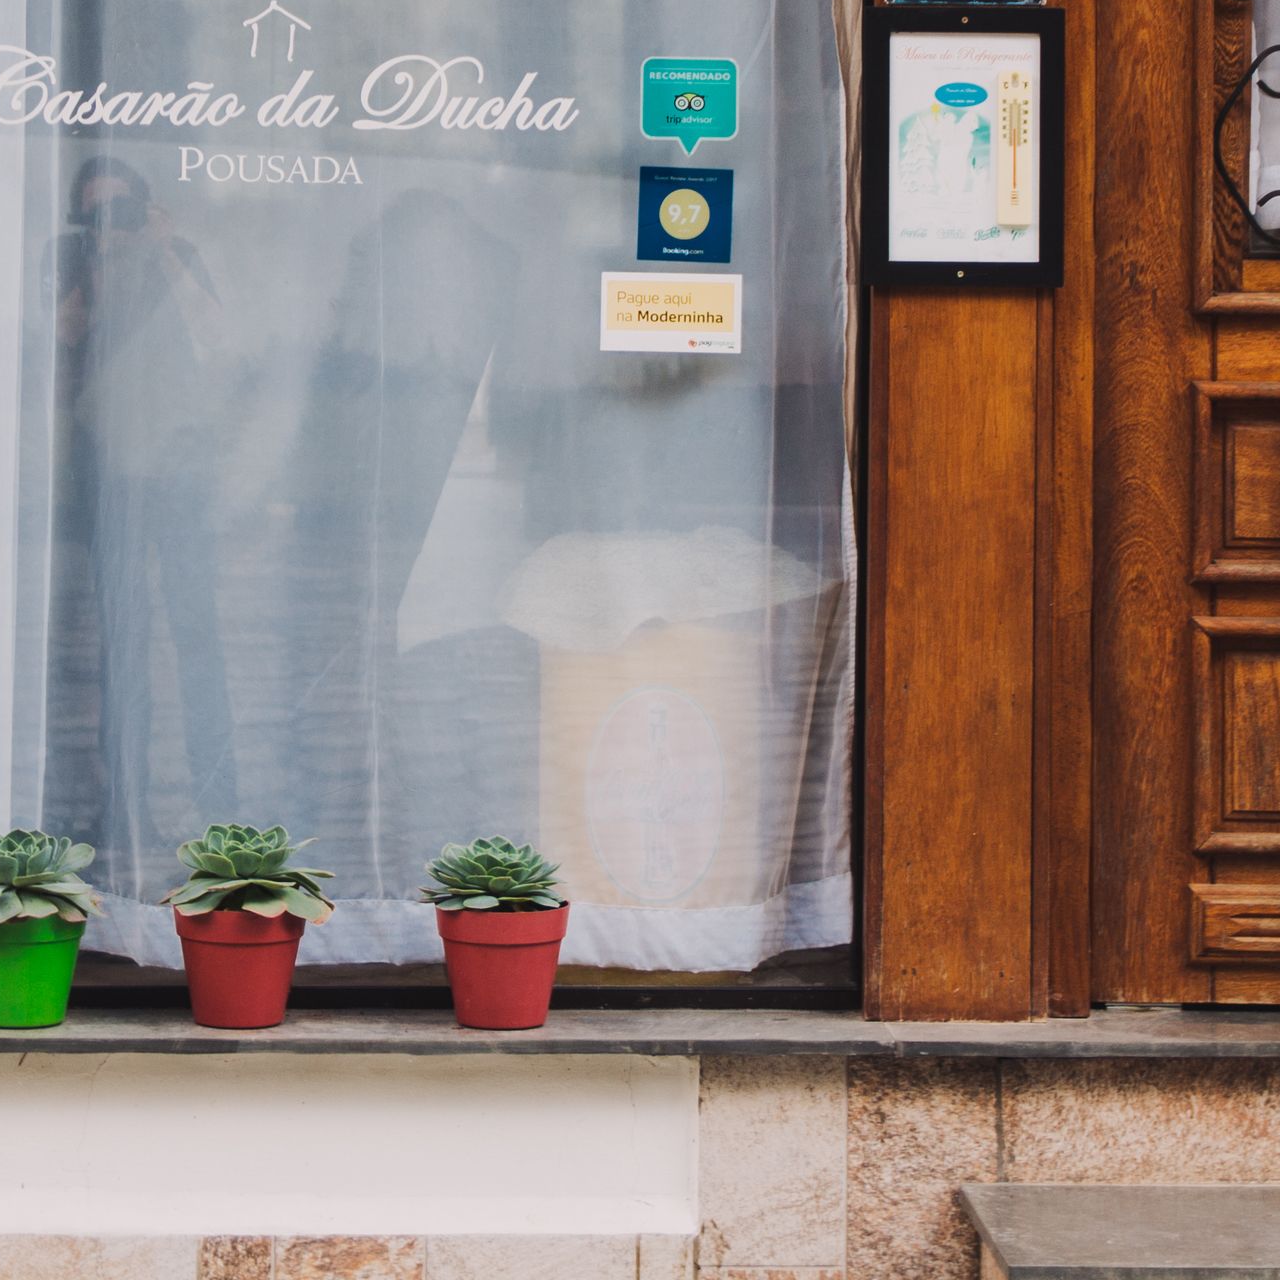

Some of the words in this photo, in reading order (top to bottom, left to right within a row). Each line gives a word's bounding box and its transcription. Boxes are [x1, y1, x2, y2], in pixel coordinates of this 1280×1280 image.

[957, 47, 1033, 65] Refrigerante
[649, 71, 731, 81] RECOMENDADO
[257, 69, 342, 129] da
[353, 53, 579, 133] Ducha
[666, 114, 713, 125] tripadvisor
[667, 203, 701, 225] 9,7
[662, 246, 704, 256] Booking.com
[616, 290, 660, 307] Pague
[663, 292, 692, 307] aqui
[616, 312, 633, 322] na
[637, 310, 724, 324] Moderninha
